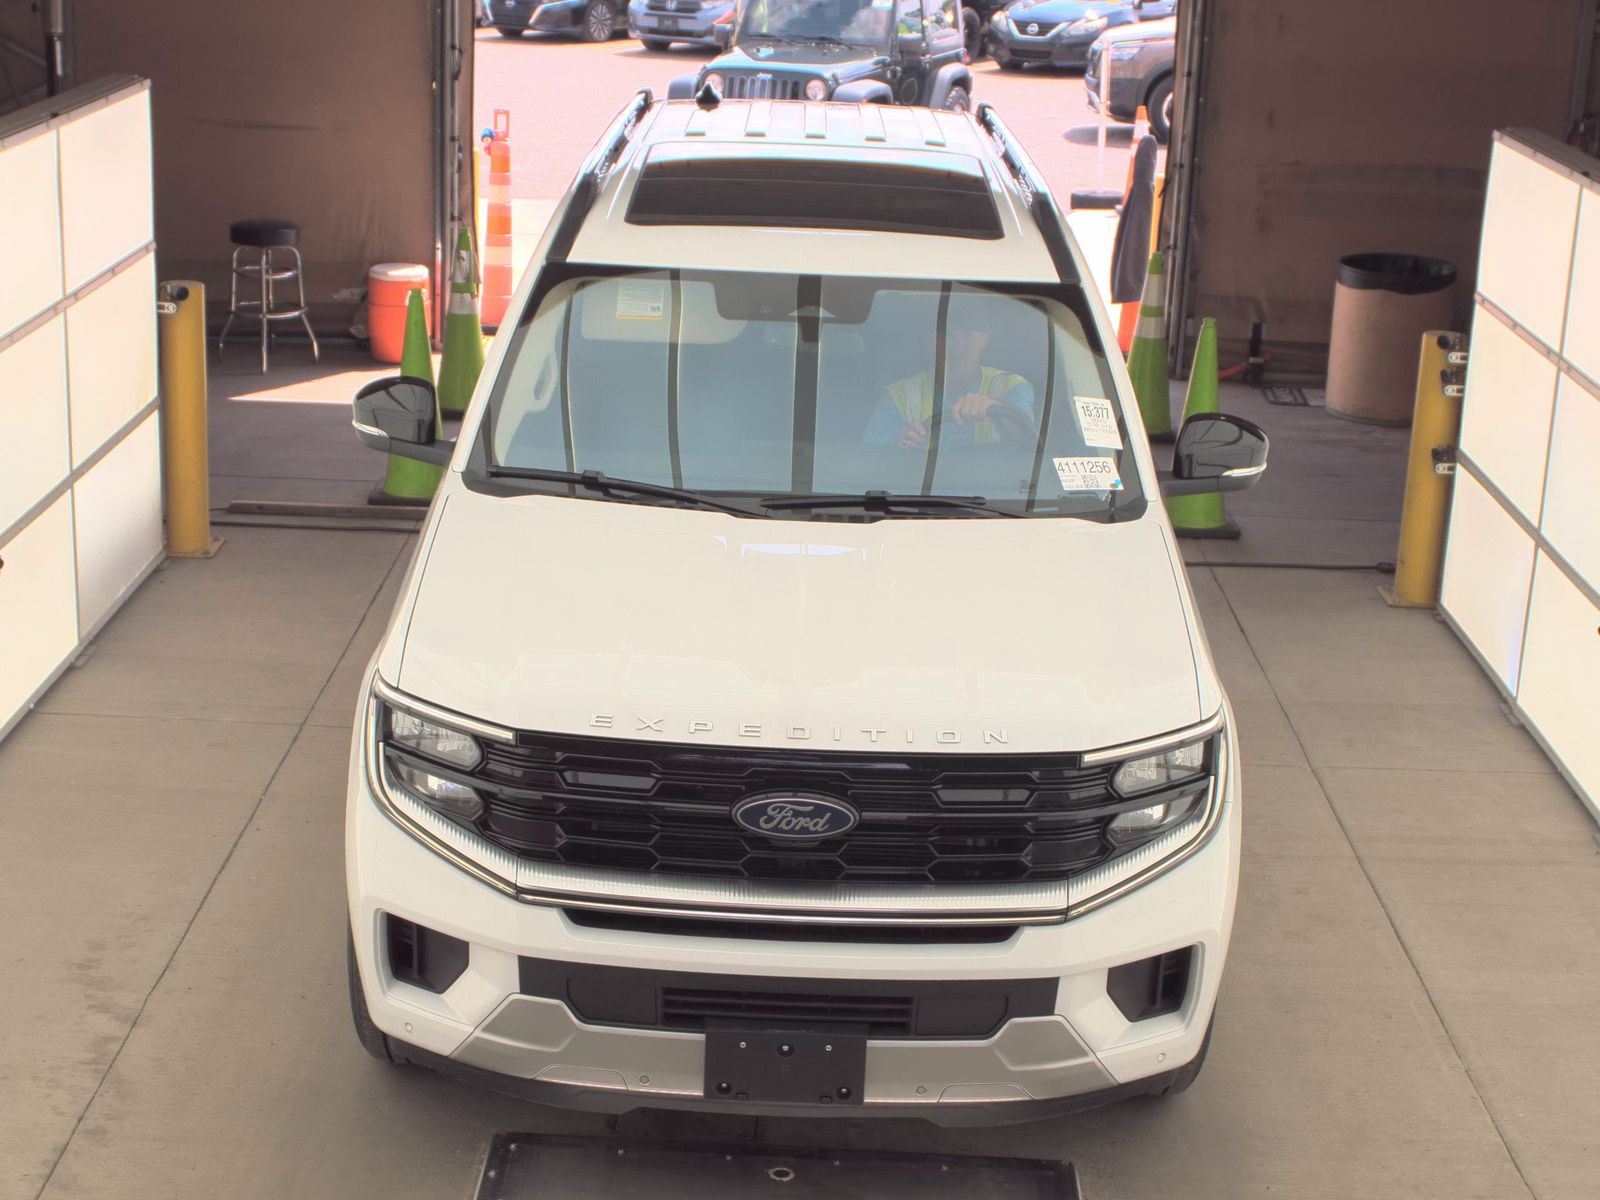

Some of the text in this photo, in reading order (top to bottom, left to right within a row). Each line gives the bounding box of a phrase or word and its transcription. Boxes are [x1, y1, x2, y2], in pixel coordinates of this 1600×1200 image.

[1057, 461, 1111, 474] 4111256
[589, 713, 1009, 744] EXPEDITION
[759, 803, 832, 832] Ford
